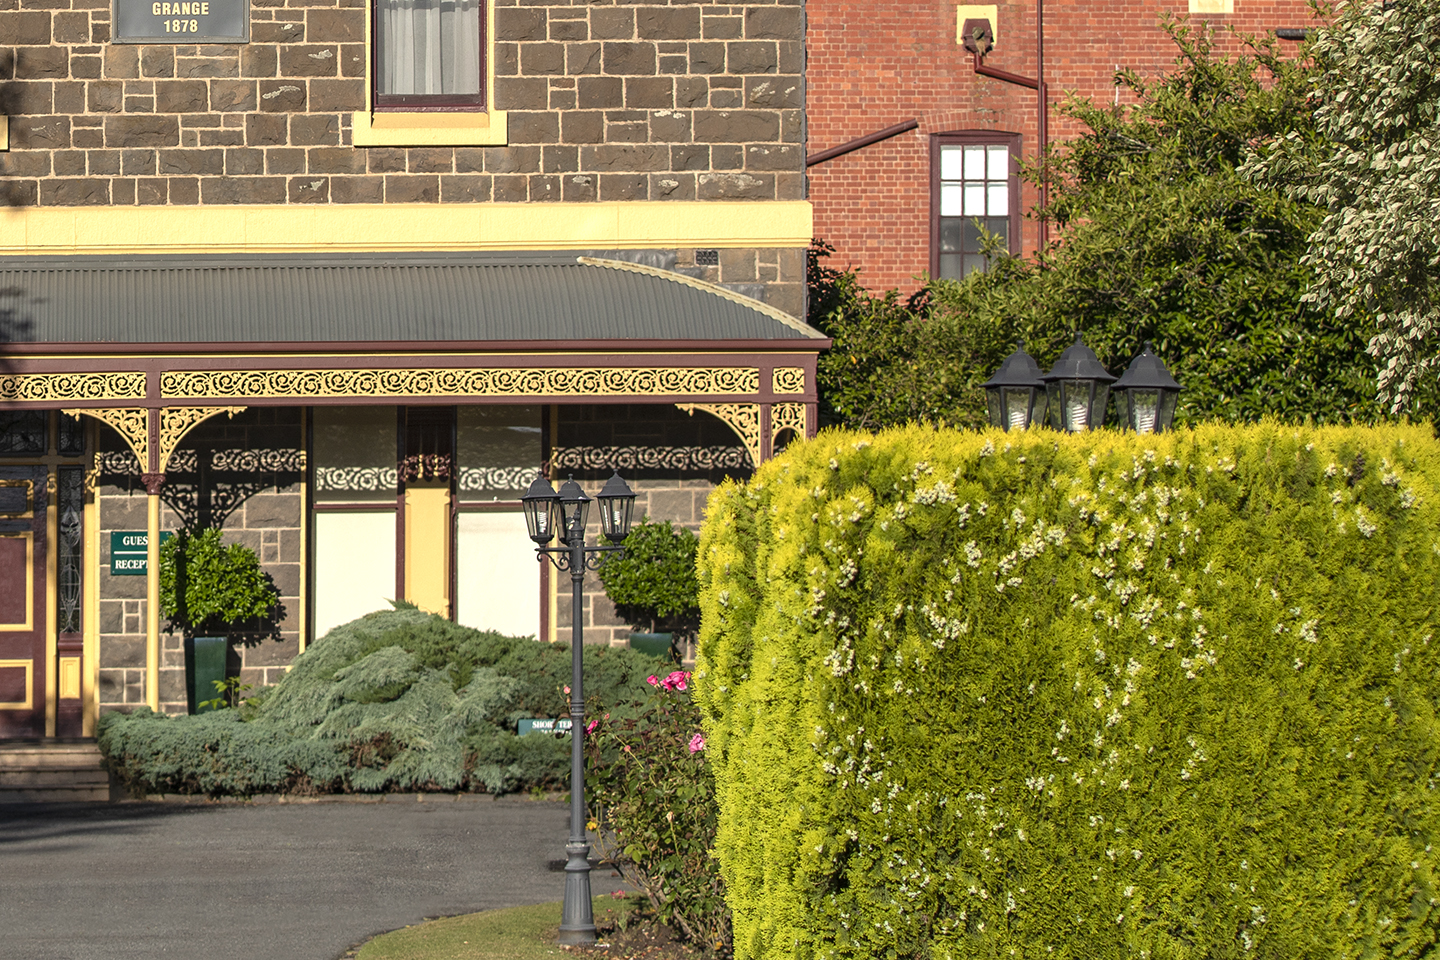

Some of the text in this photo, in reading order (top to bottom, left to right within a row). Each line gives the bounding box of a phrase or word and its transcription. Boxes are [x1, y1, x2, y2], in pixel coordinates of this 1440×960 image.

[152, 2, 209, 15] GRANGE
[163, 19, 198, 33] 1878
[122, 536, 148, 546] GUES
[532, 720, 555, 729] SHOR
